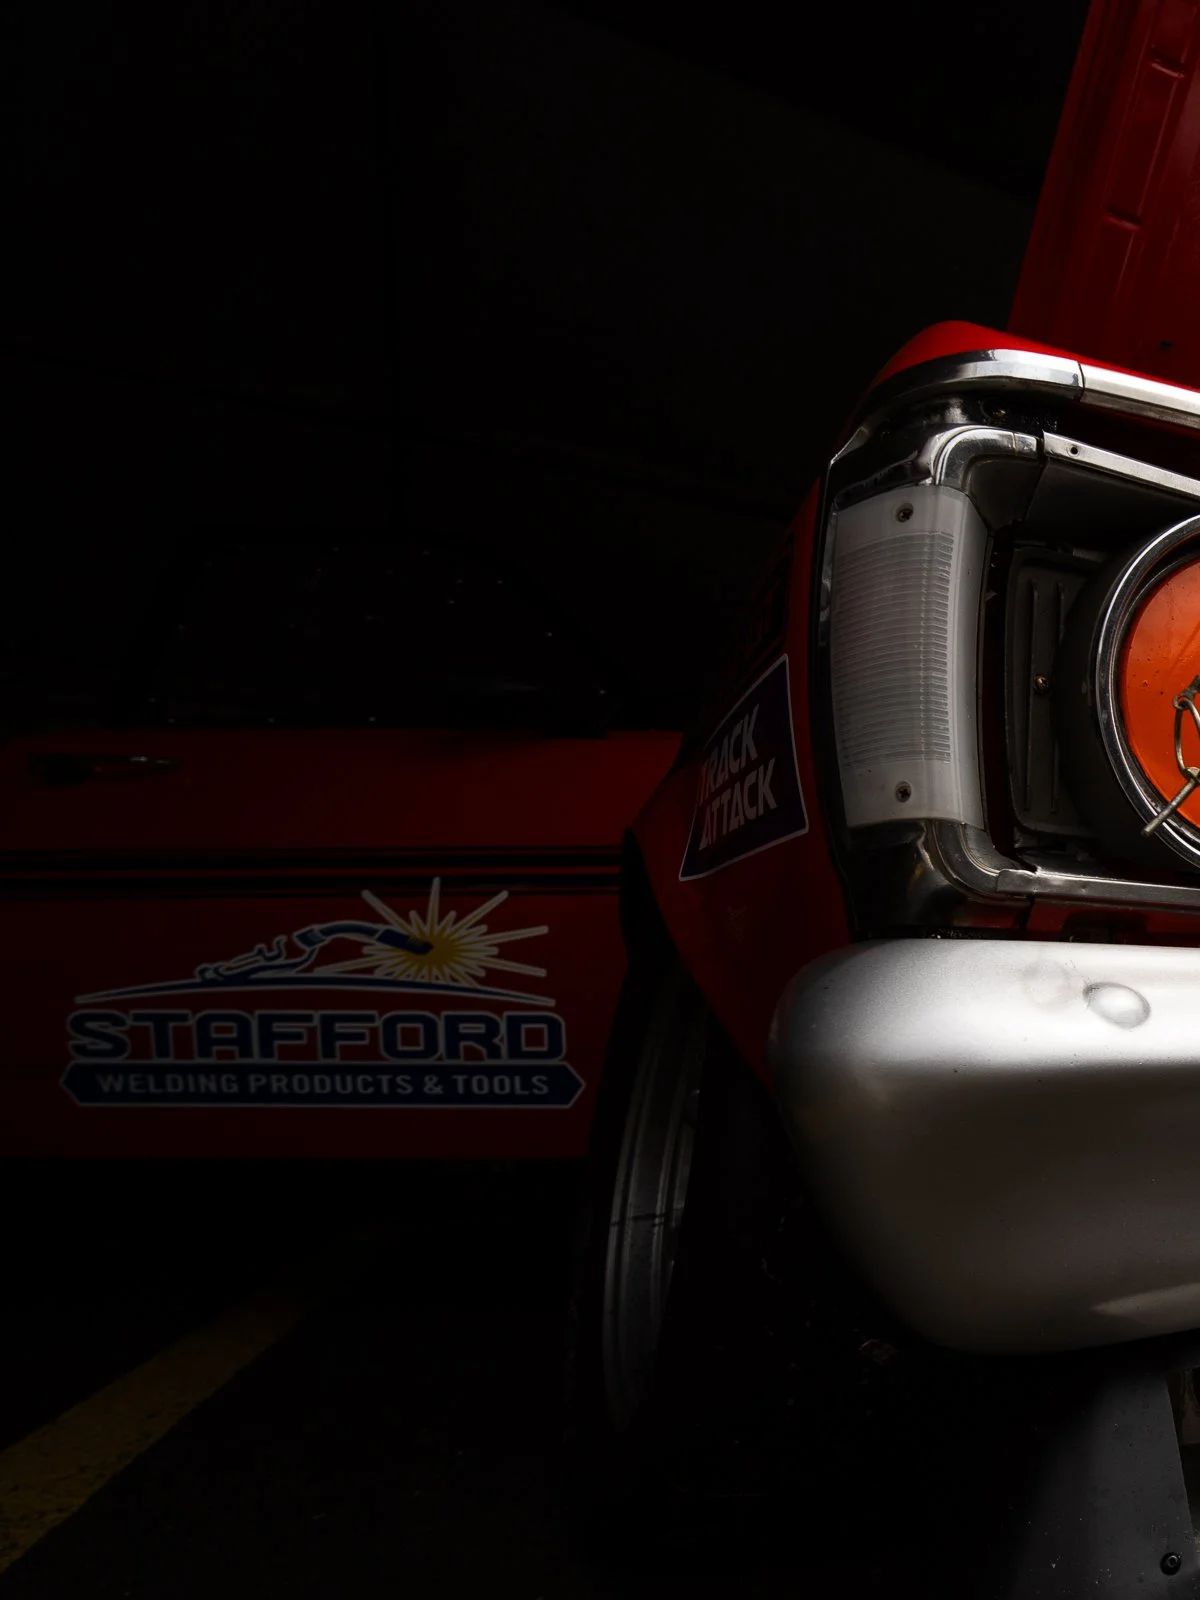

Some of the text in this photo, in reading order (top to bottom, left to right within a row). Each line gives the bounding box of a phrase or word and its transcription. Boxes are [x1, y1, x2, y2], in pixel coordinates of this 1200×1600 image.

[700, 703, 760, 808] TRACK
[699, 756, 778, 851] ATTACK
[66, 1009, 566, 1063] STAFFORD
[95, 1072, 549, 1096] WELDING PRODUCTS & TOOLS
